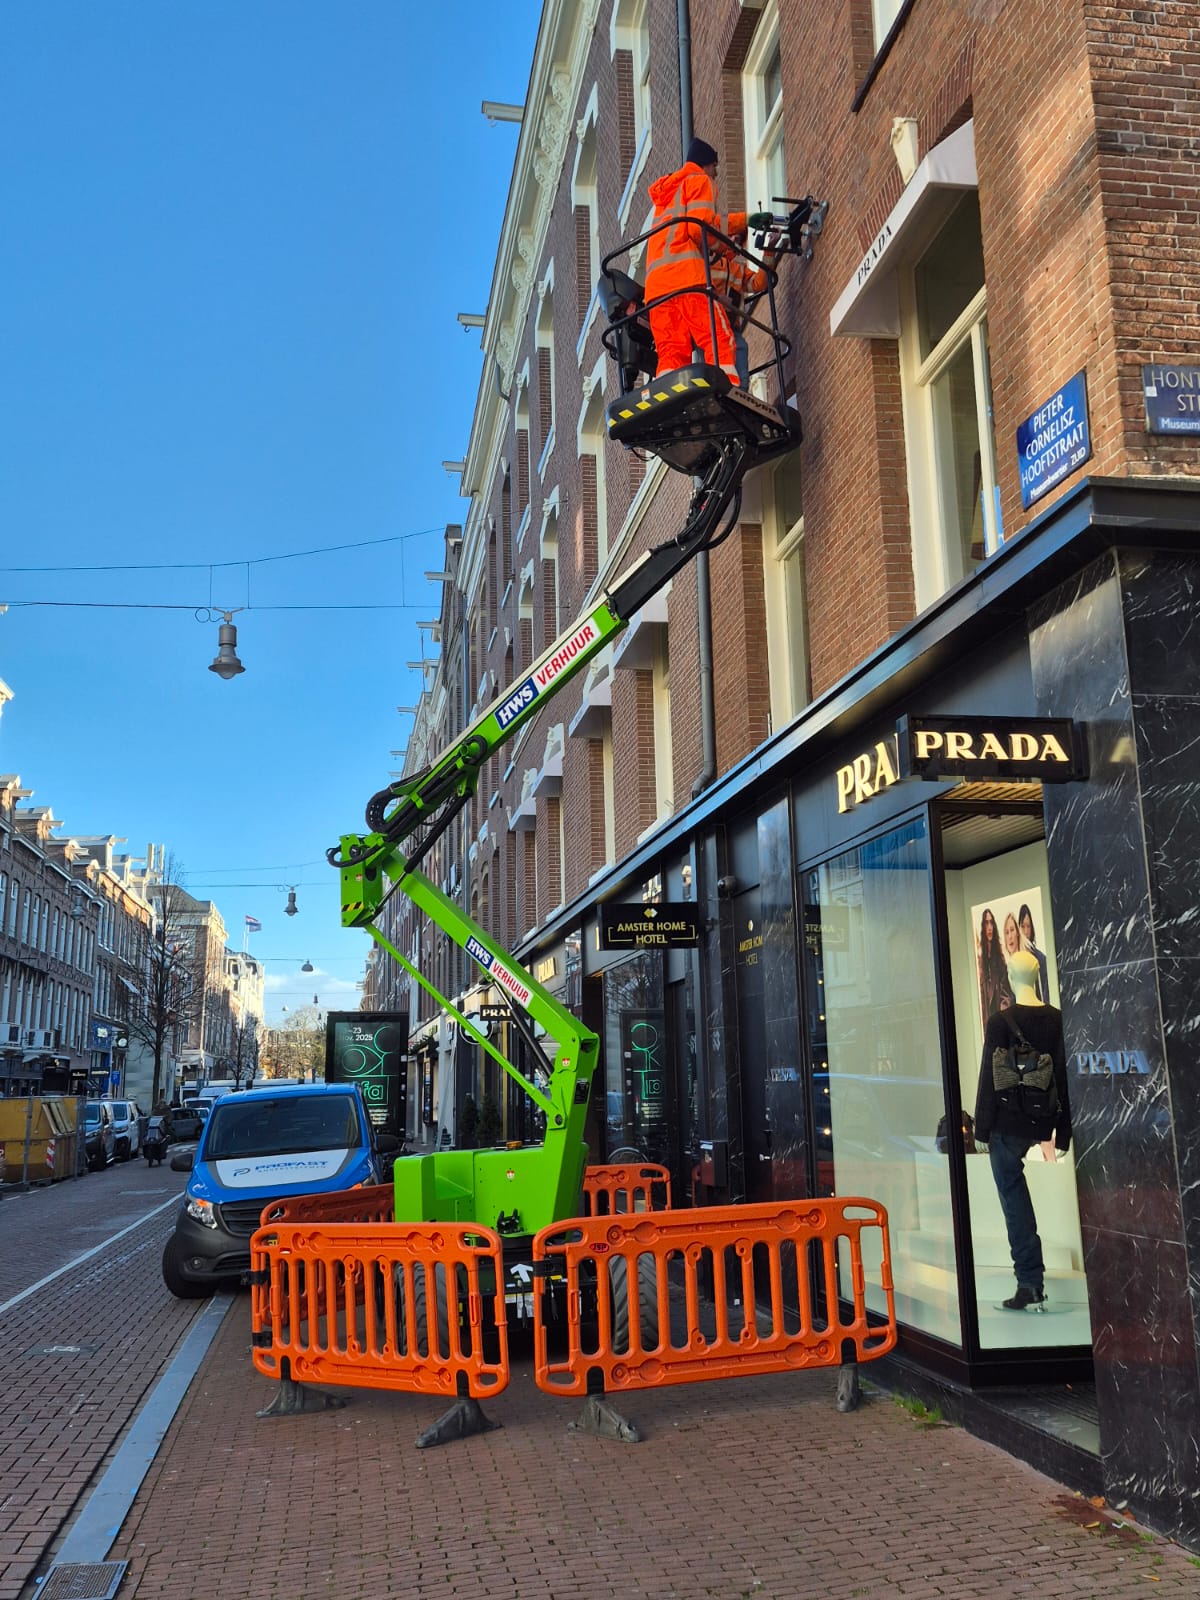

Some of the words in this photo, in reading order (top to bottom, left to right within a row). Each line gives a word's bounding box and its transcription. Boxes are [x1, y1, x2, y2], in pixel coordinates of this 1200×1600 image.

[858, 225, 892, 286] PRADA
[1033, 394, 1064, 433] PIETER
[1177, 394, 1200, 412] ST
[1025, 406, 1076, 461] CORNELISZ
[1021, 421, 1085, 489] HOOFTSTRAAT
[1070, 447, 1086, 466] ZUID
[497, 685, 533, 725] HWS
[536, 625, 595, 686] VERHUUR
[915, 731, 1070, 762] PRADA
[836, 733, 900, 814] PRA
[617, 922, 654, 932] AMSTER
[656, 921, 687, 931] HOME
[635, 934, 668, 945] HOTEL
[753, 935, 763, 948] HOM
[466, 938, 491, 965] HWS
[492, 962, 530, 1003] VERHUUR
[482, 1008, 511, 1018] PRA
[1077, 1050, 1152, 1075] PRADA
